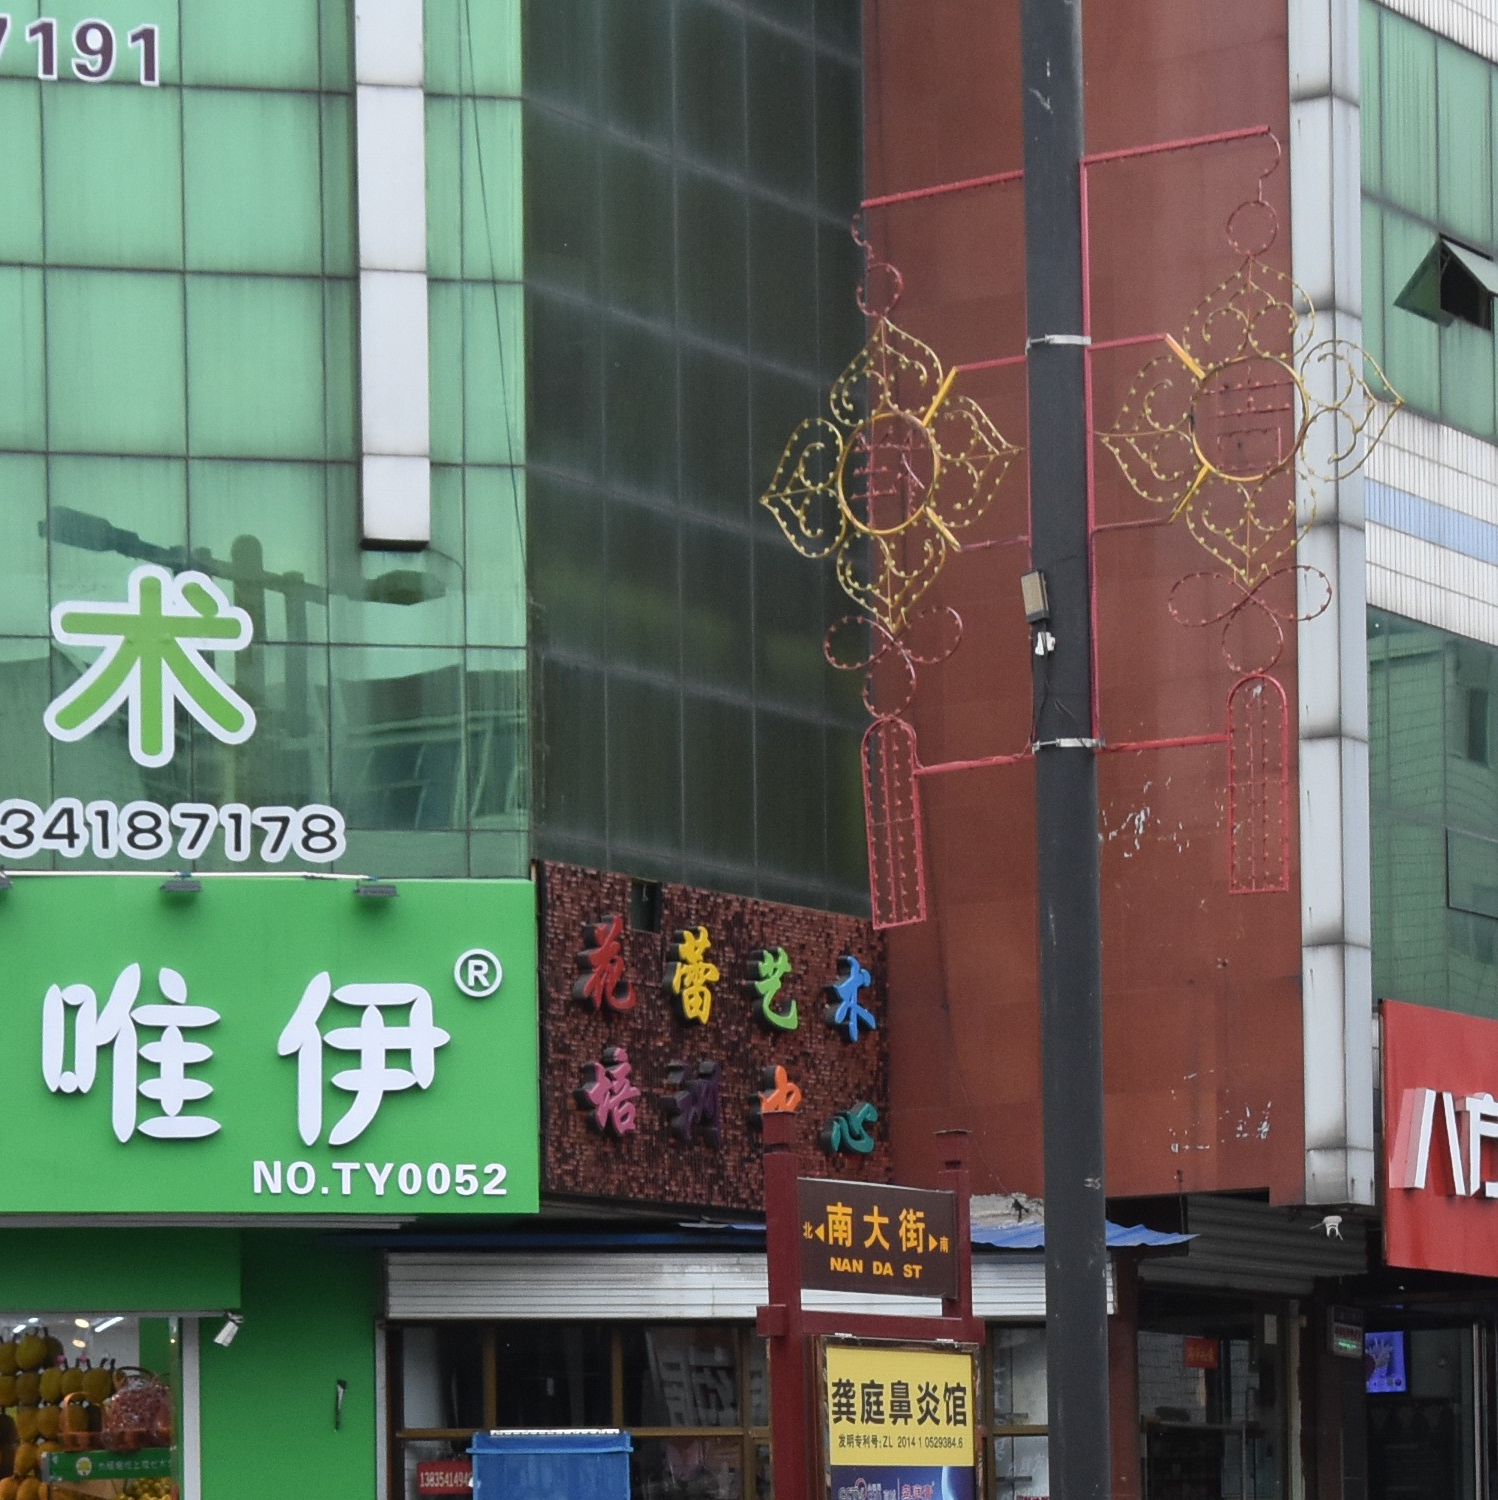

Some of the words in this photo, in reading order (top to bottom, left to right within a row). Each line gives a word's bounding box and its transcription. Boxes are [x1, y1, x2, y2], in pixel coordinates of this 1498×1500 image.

[579, 915, 877, 1043] 花蕾艺术
[253, 1161, 508, 1197] NO.TY0052
[802, 1221, 813, 1239] 北
[826, 1201, 926, 1254] 南大街
[939, 1235, 950, 1254] 南
[830, 1256, 864, 1274] NAN
[872, 1261, 894, 1277] DA
[903, 1264, 923, 1279] ST
[831, 1377, 968, 1427] 龚庭鼻炎馆
[897, 1436, 916, 1449] 2014
